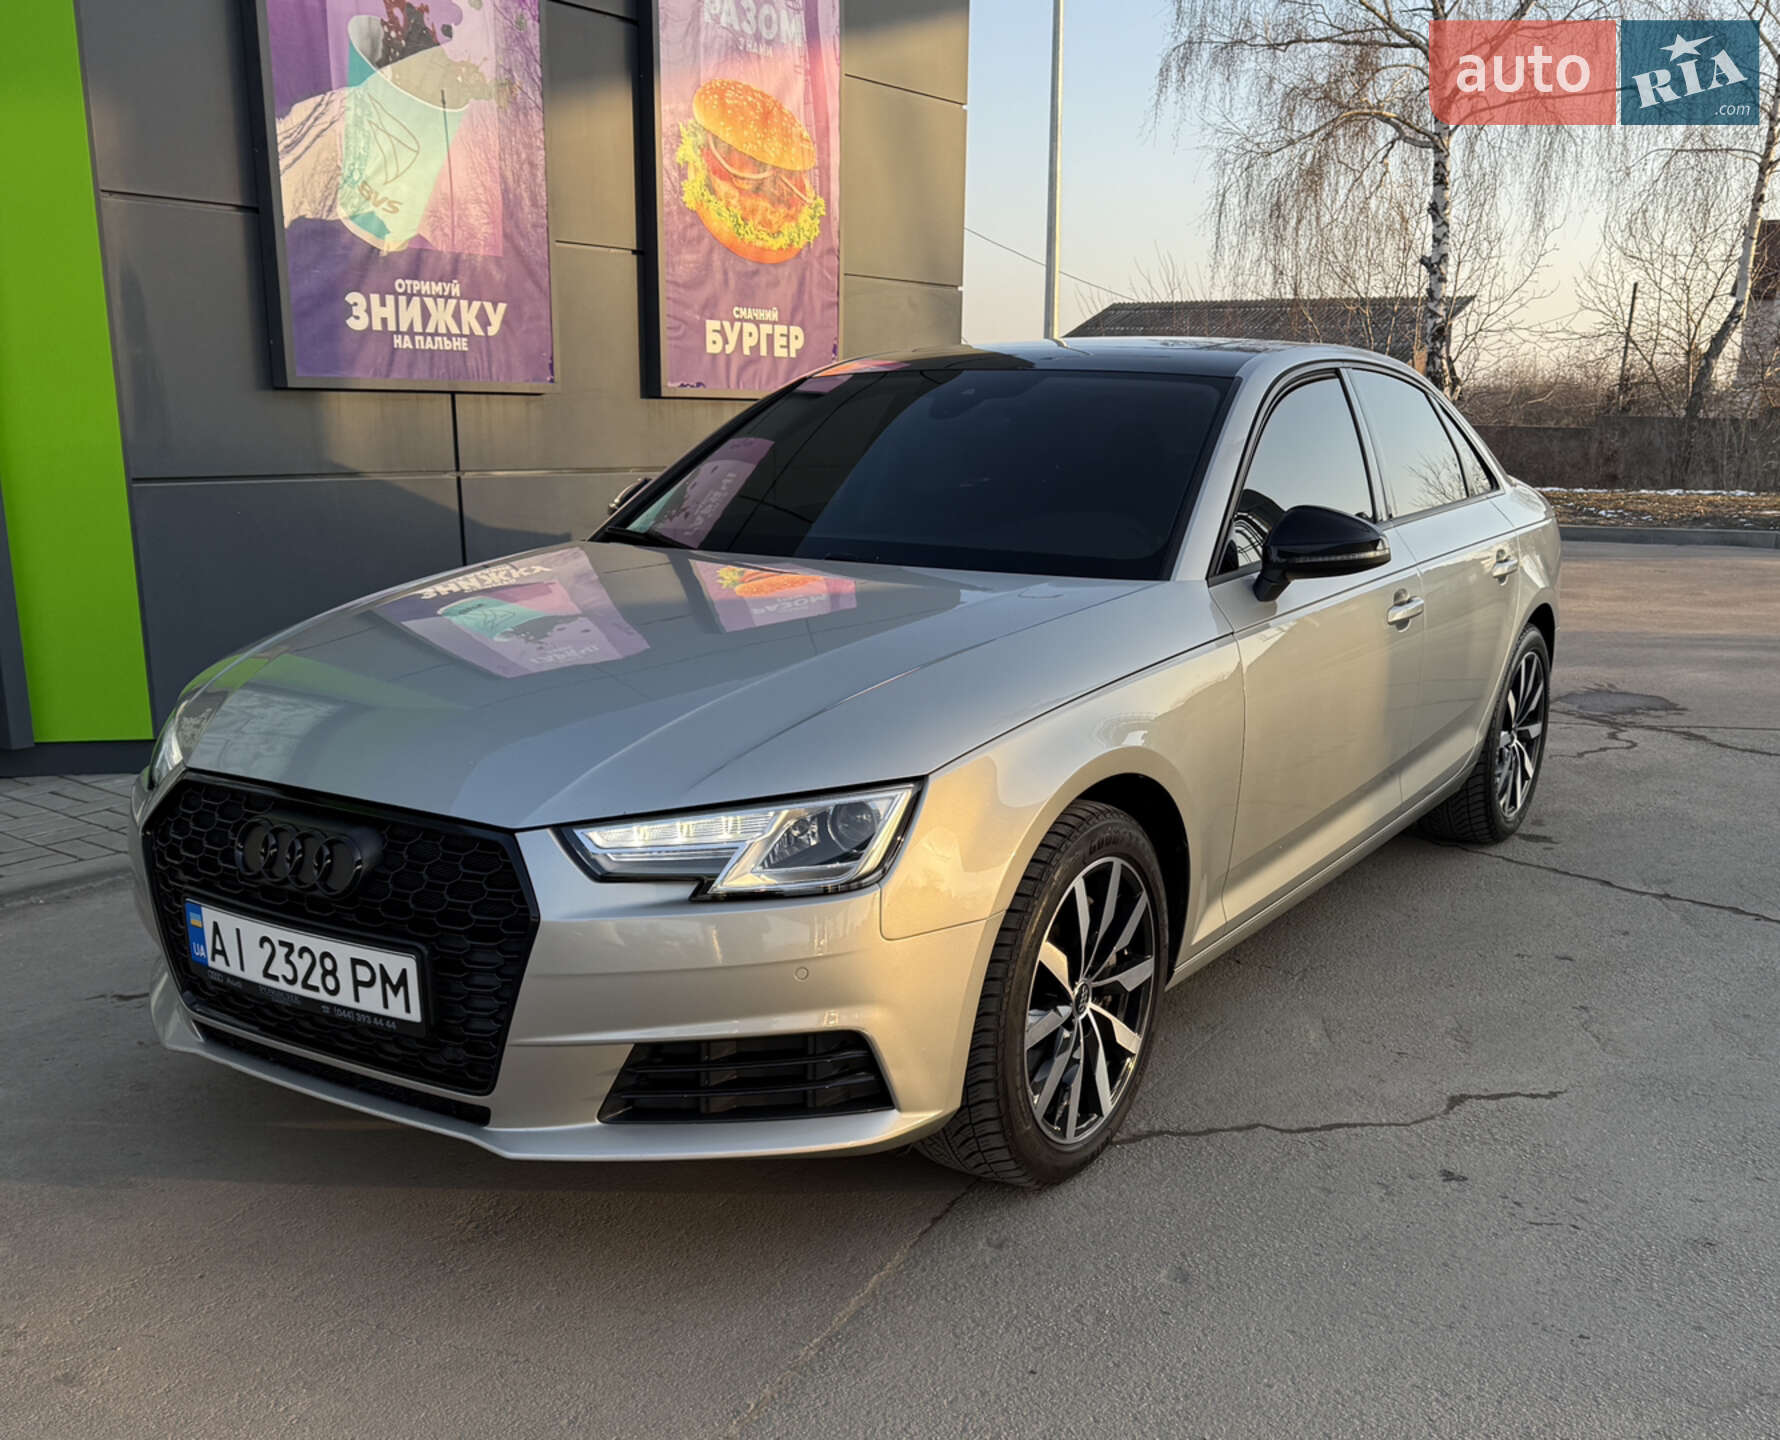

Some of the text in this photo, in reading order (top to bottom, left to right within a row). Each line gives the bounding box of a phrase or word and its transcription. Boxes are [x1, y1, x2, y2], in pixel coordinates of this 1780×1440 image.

[394, 278, 461, 297] ОТРИМУЙ
[344, 291, 508, 337] ЗНИЖКУ
[733, 306, 779, 321] СМАЧНИЙ
[393, 334, 469, 351] НА ПАЛЬНЕ
[705, 319, 805, 358] БУРГЕР
[192, 941, 207, 959] UA
[210, 920, 412, 1014] AI 2328 PM
